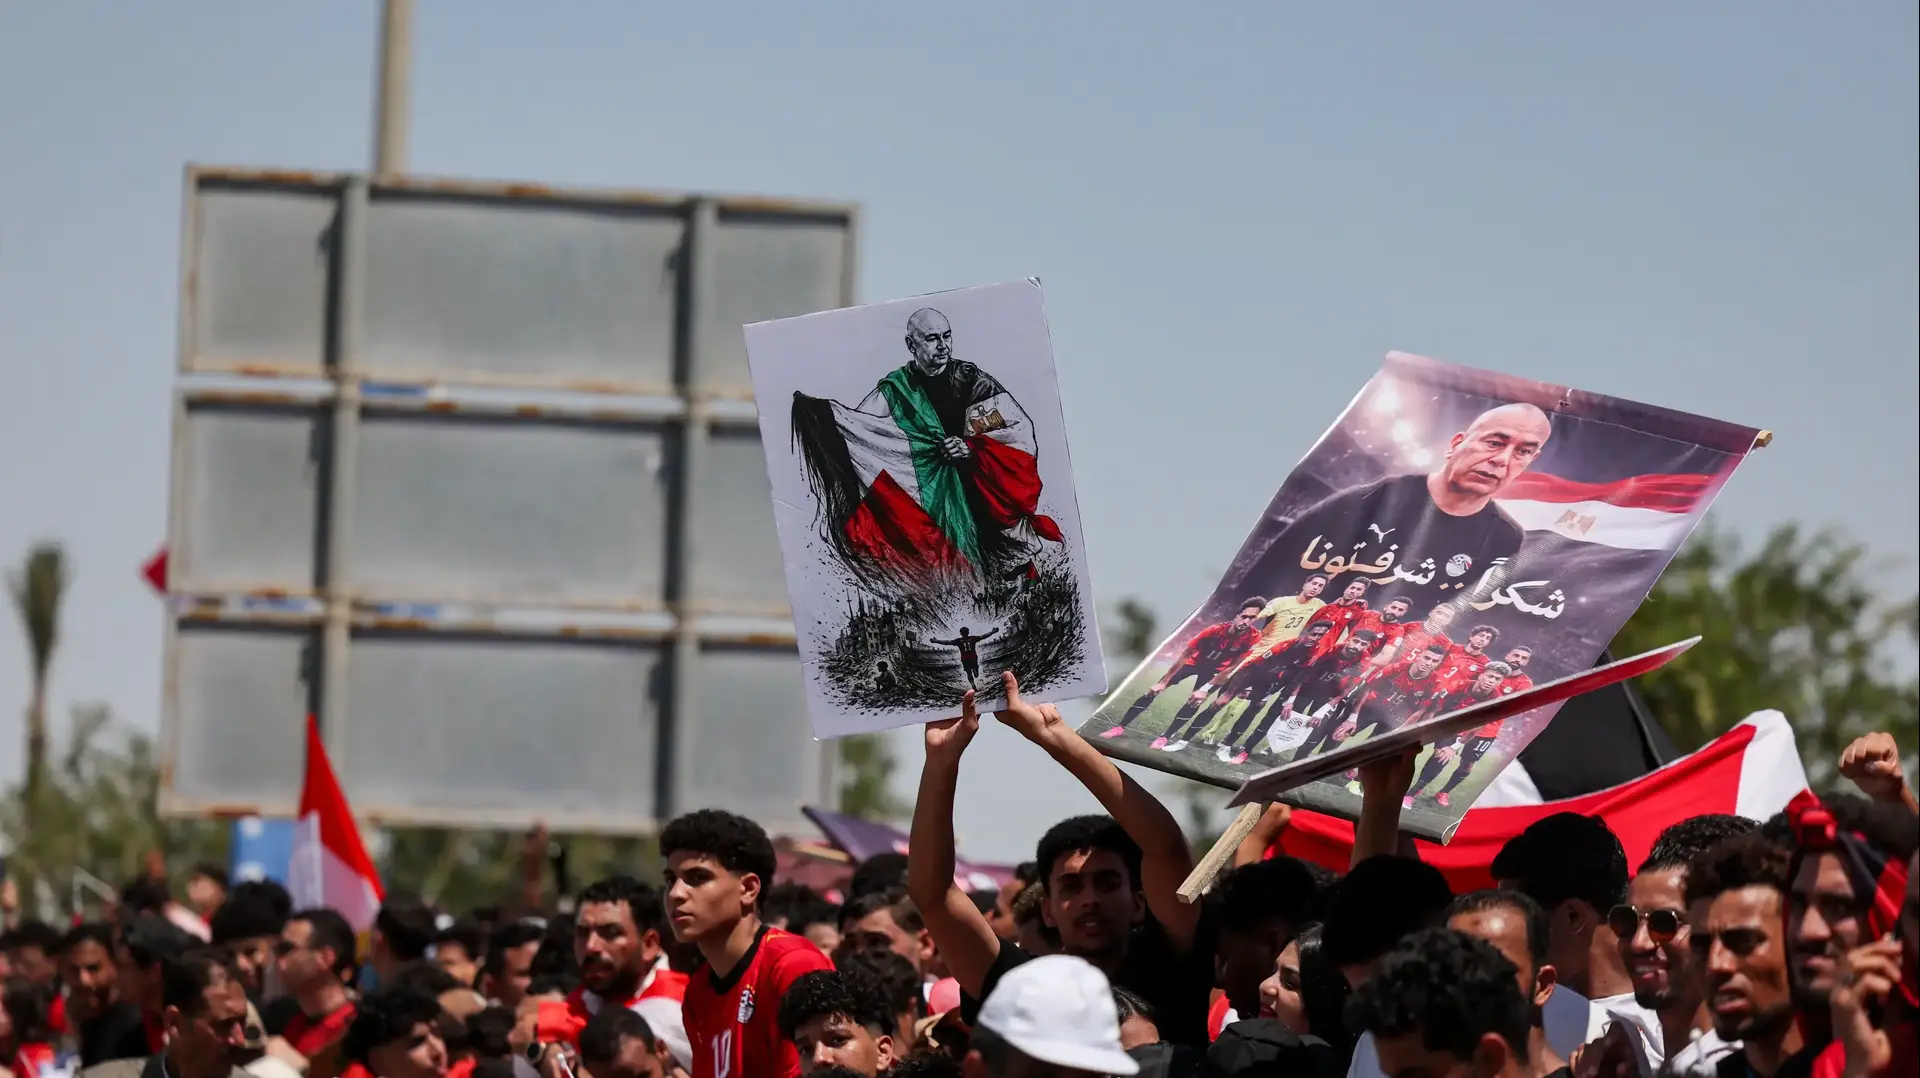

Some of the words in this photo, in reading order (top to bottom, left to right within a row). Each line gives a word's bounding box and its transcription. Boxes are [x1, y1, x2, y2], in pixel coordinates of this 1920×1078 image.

[1300, 534, 1436, 585] شرفتونا
[1285, 616, 1304, 629] 23
[963, 641, 972, 652] 11
[1407, 648, 1421, 661] 5
[1444, 667, 1459, 679] 3
[1473, 740, 1491, 752] 10
